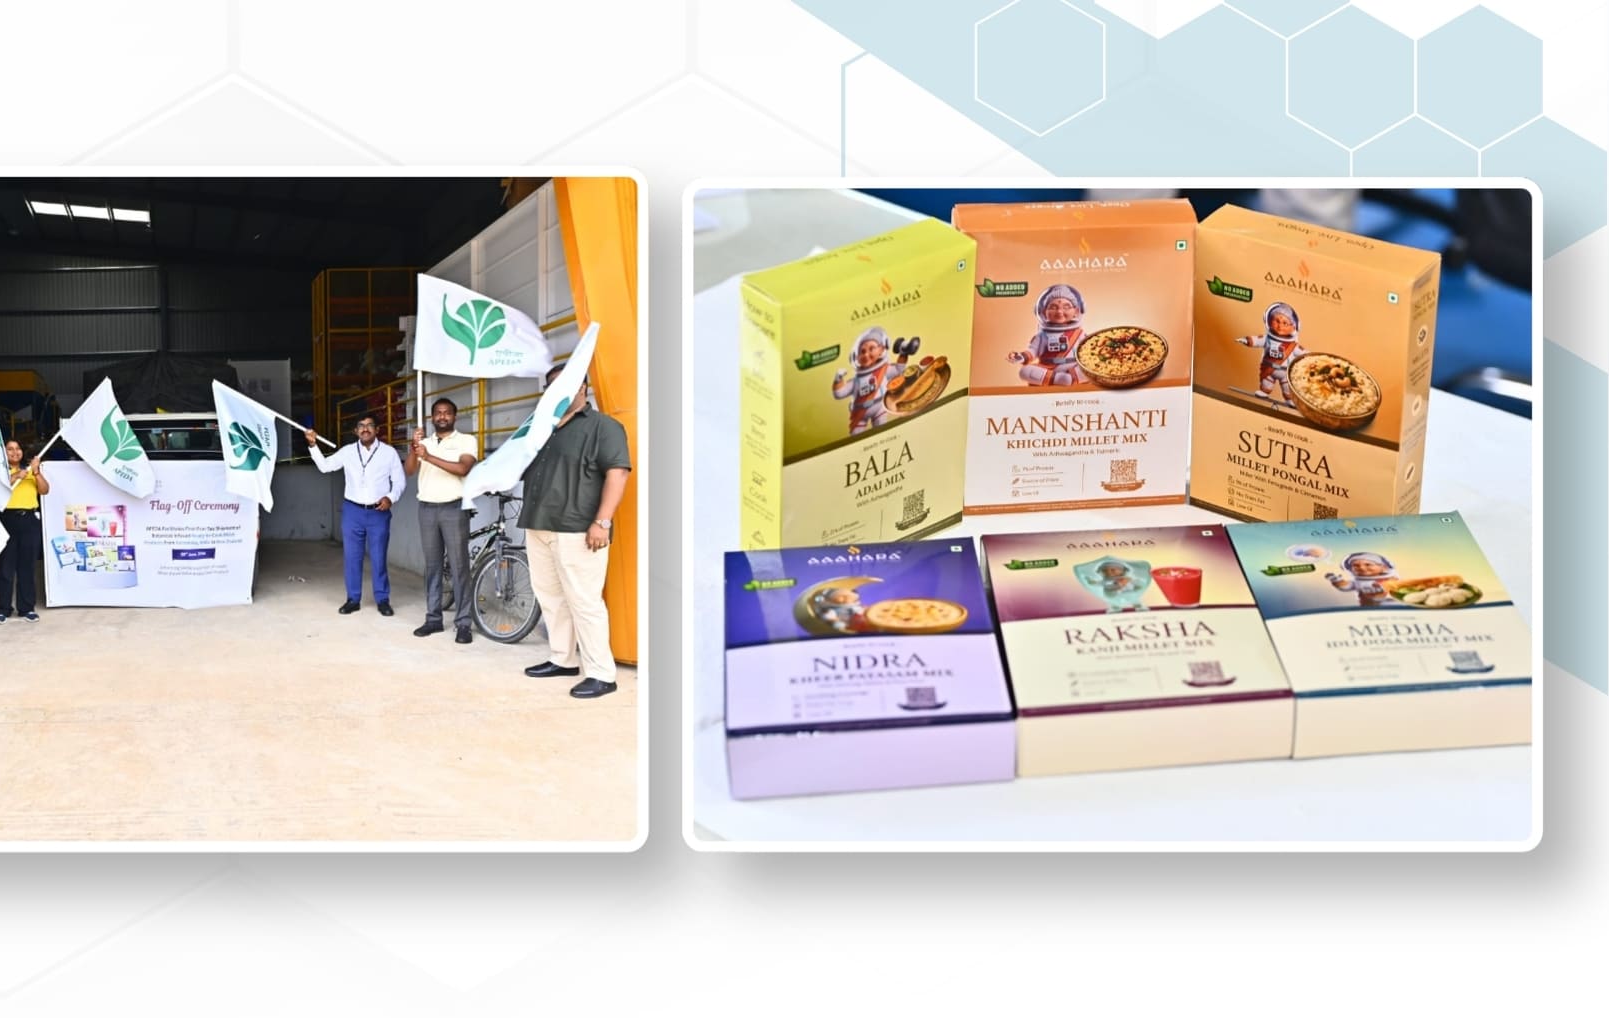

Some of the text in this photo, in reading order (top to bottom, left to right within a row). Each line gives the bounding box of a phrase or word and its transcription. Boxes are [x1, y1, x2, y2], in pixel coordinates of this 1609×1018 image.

[1040, 256, 1128, 270] AAAHARA
[1264, 271, 1342, 300] AAAHARA
[985, 409, 1168, 436] MANNSHANTI
[1006, 433, 1148, 450] KHICHDI MILLET MIX
[844, 440, 915, 488] BALA
[1238, 430, 1334, 480] SUTRA
[855, 470, 906, 499] ADAI MIX
[1226, 452, 1271, 474] MILLET
[1272, 465, 1323, 491] PONGAL
[1324, 482, 1351, 499] MIX
[149, 499, 240, 514] Flag-Off Ceremony
[807, 552, 901, 565] AAAHARA
[1065, 620, 1216, 645] RAKSHA
[1348, 623, 1454, 638] MEDHA
[813, 653, 926, 672] NIDRA
